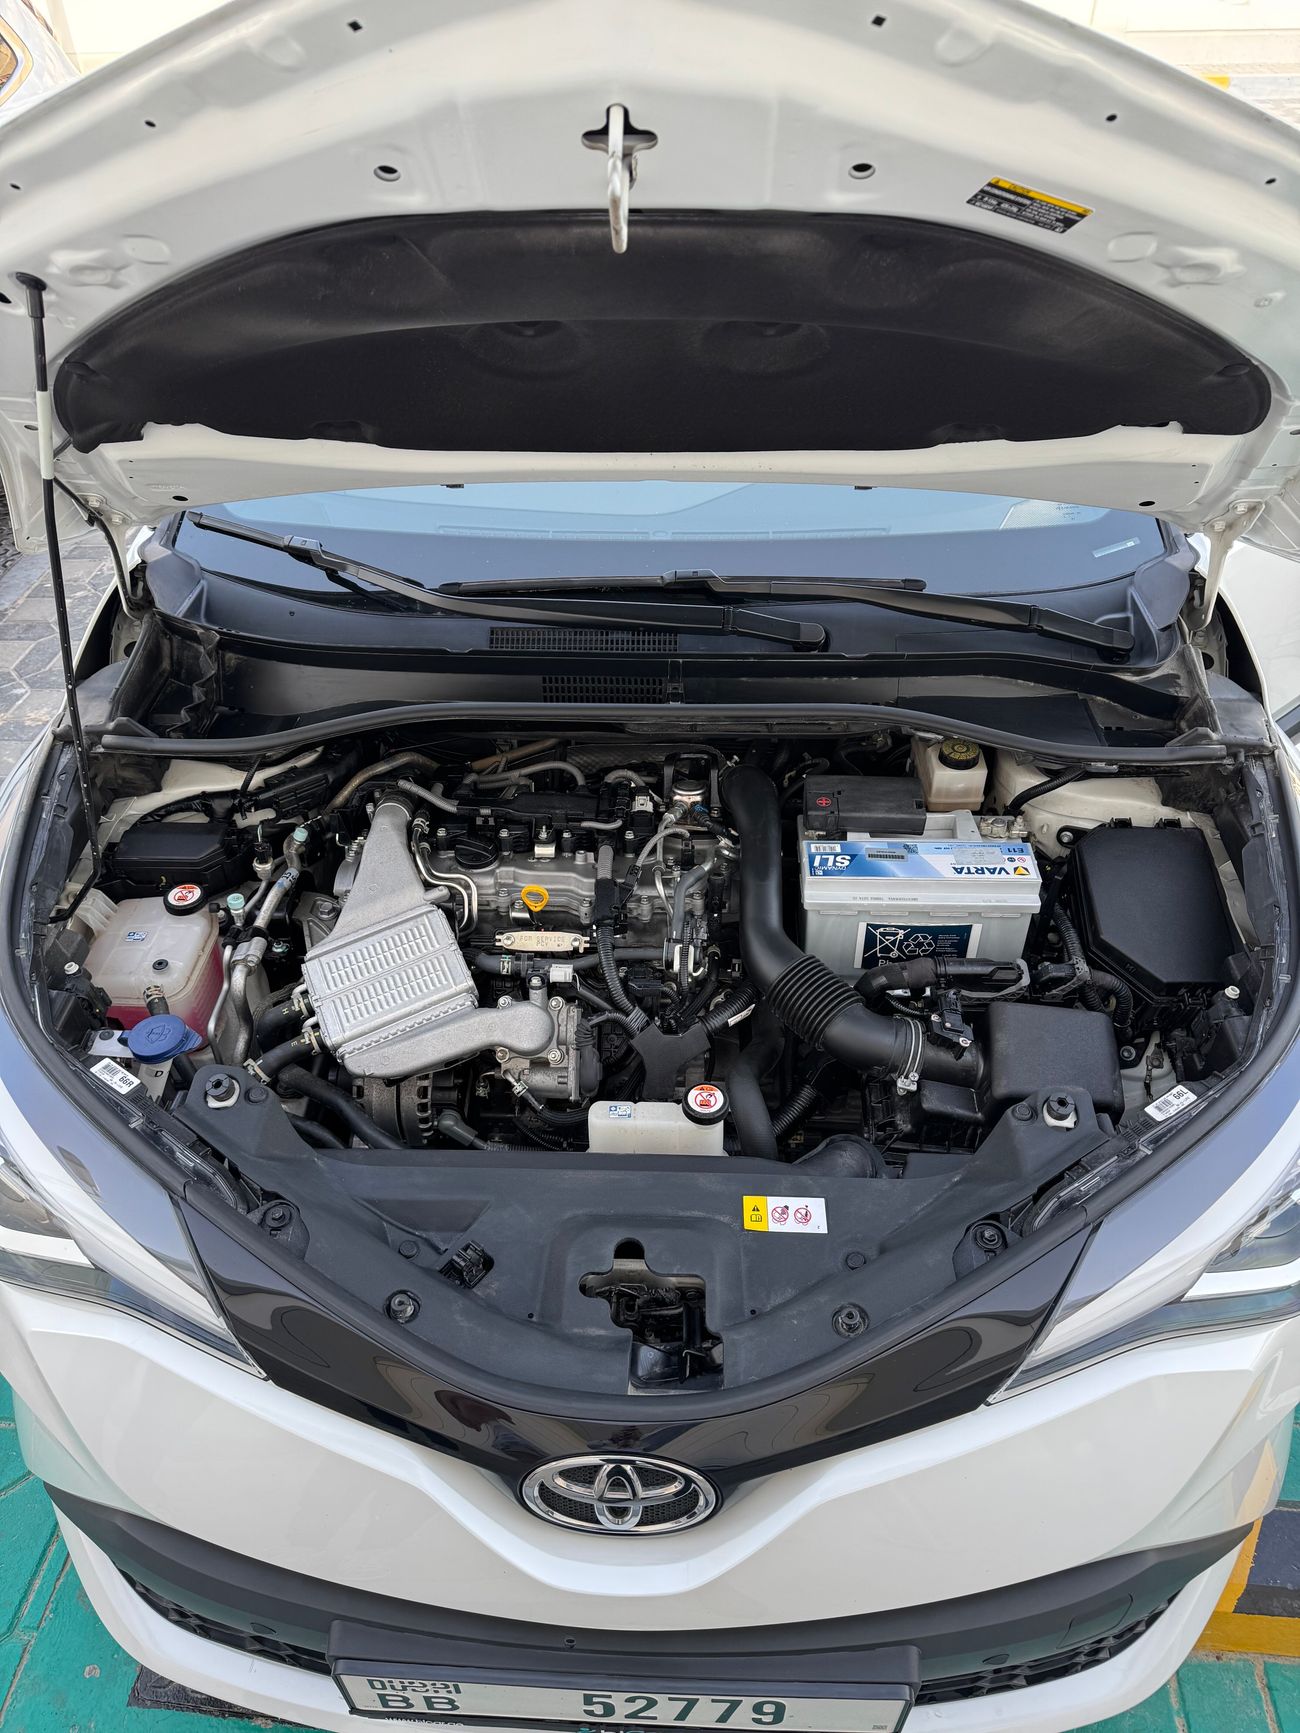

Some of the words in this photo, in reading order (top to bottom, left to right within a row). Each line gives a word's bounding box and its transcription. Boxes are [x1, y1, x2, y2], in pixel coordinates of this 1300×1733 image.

[813, 855, 851, 868] SLI
[951, 866, 1011, 875] VARTA
[118, 1075, 135, 1088] 66R
[1172, 1089, 1189, 1100] 66L
[582, 1693, 787, 1726] 52779
